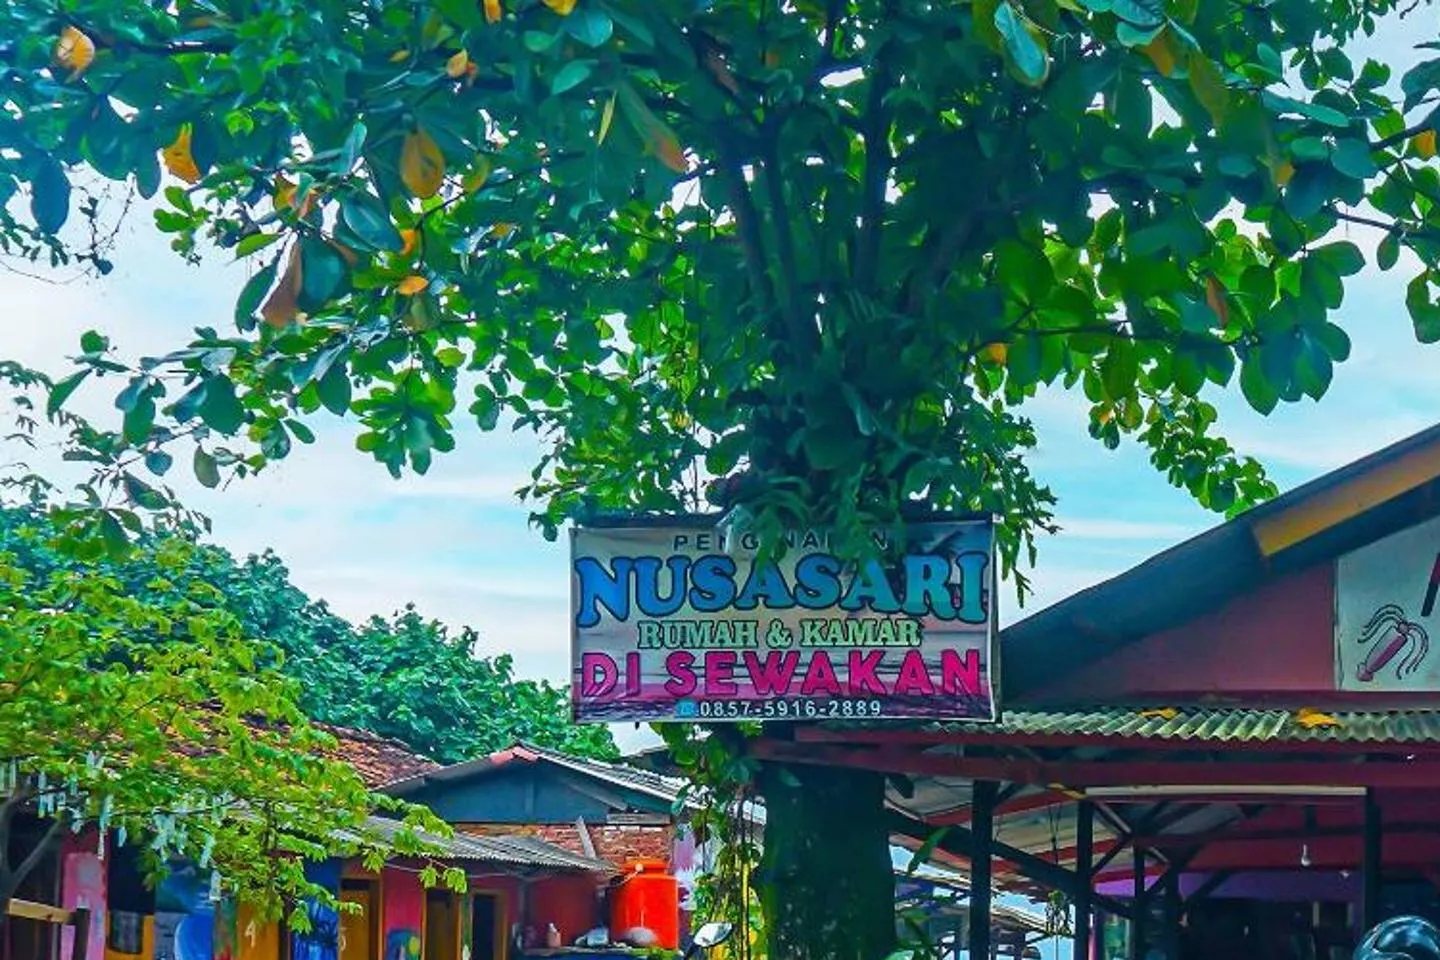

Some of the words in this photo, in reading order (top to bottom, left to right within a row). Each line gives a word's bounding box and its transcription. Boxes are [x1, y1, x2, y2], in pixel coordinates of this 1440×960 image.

[574, 552, 989, 627] NUSASARI
[637, 619, 757, 649] RUMAH
[766, 619, 792, 648] &
[801, 619, 923, 648] KAMAR
[581, 652, 641, 698] DI
[664, 649, 985, 698] SEWAKAN
[699, 700, 882, 718] 0857-5916-2889
